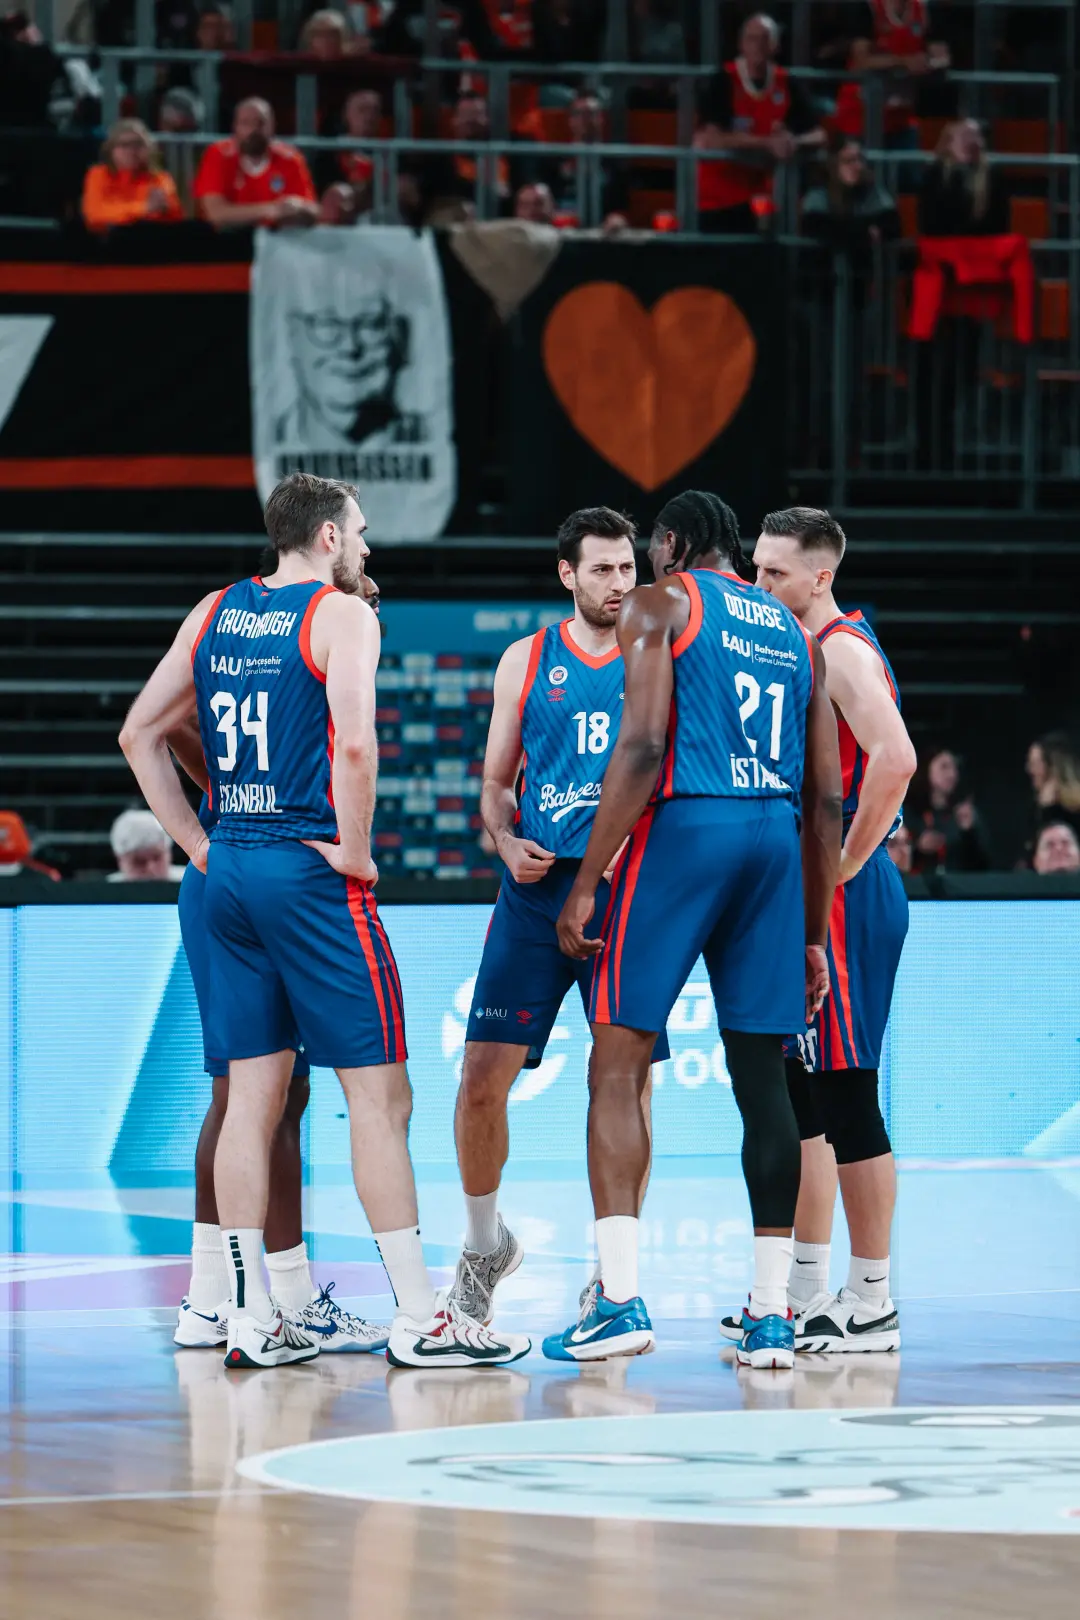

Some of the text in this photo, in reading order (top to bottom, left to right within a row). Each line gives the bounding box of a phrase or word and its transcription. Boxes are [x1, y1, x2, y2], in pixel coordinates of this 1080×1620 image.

[723, 592, 786, 632] ODIASE
[721, 630, 751, 657] BAU
[209, 691, 270, 772] 34
[572, 711, 611, 754] 18
[734, 671, 785, 761] 21
[485, 1007, 508, 1018] BAU
